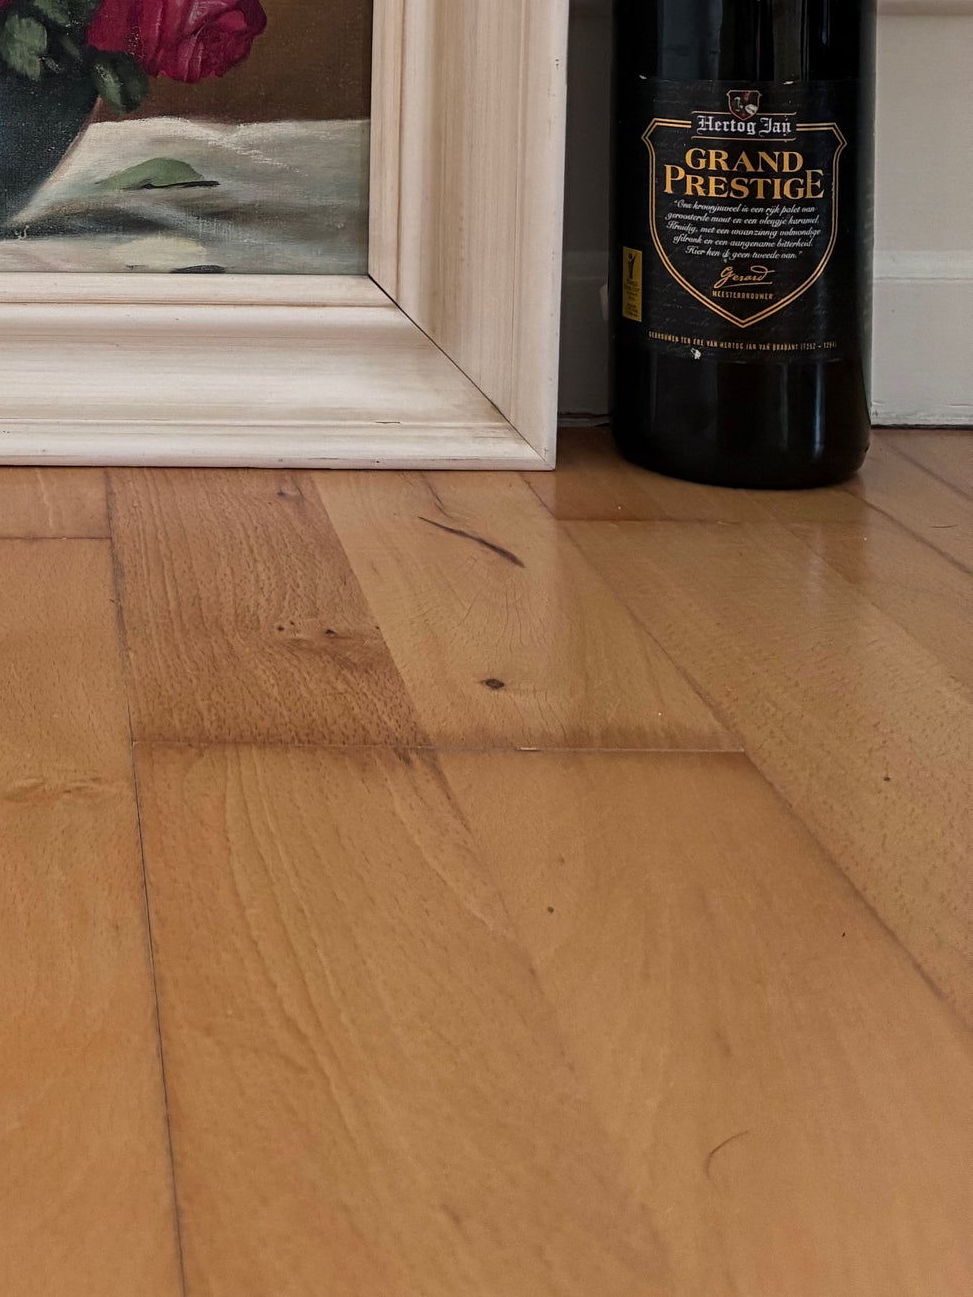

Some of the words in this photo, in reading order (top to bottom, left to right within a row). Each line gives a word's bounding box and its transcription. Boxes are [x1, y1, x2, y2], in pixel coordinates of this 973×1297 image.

[696, 115, 757, 136] Hertog
[759, 117, 792, 138] Jan
[685, 147, 804, 173] GRAND
[664, 164, 825, 200] PRESTIGE
[693, 201, 742, 214] kroonjuweel
[741, 205, 749, 213] is
[765, 204, 780, 216] rijk
[779, 204, 801, 216] palet
[665, 212, 710, 222] geroosterde
[759, 216, 787, 227] vleugje
[788, 214, 820, 224] karamel.
[666, 221, 698, 234] Kruidig,
[731, 228, 778, 239] waanzinnig
[779, 226, 821, 238] volmondige
[672, 233, 702, 244] afdronk
[730, 240, 775, 250] aangename
[776, 238, 813, 247] bitterheid.
[685, 245, 706, 255] Hier
[706, 247, 720, 256] ken
[722, 249, 731, 258] ik
[729, 252, 751, 260] geen
[752, 250, 780, 259] tweede
